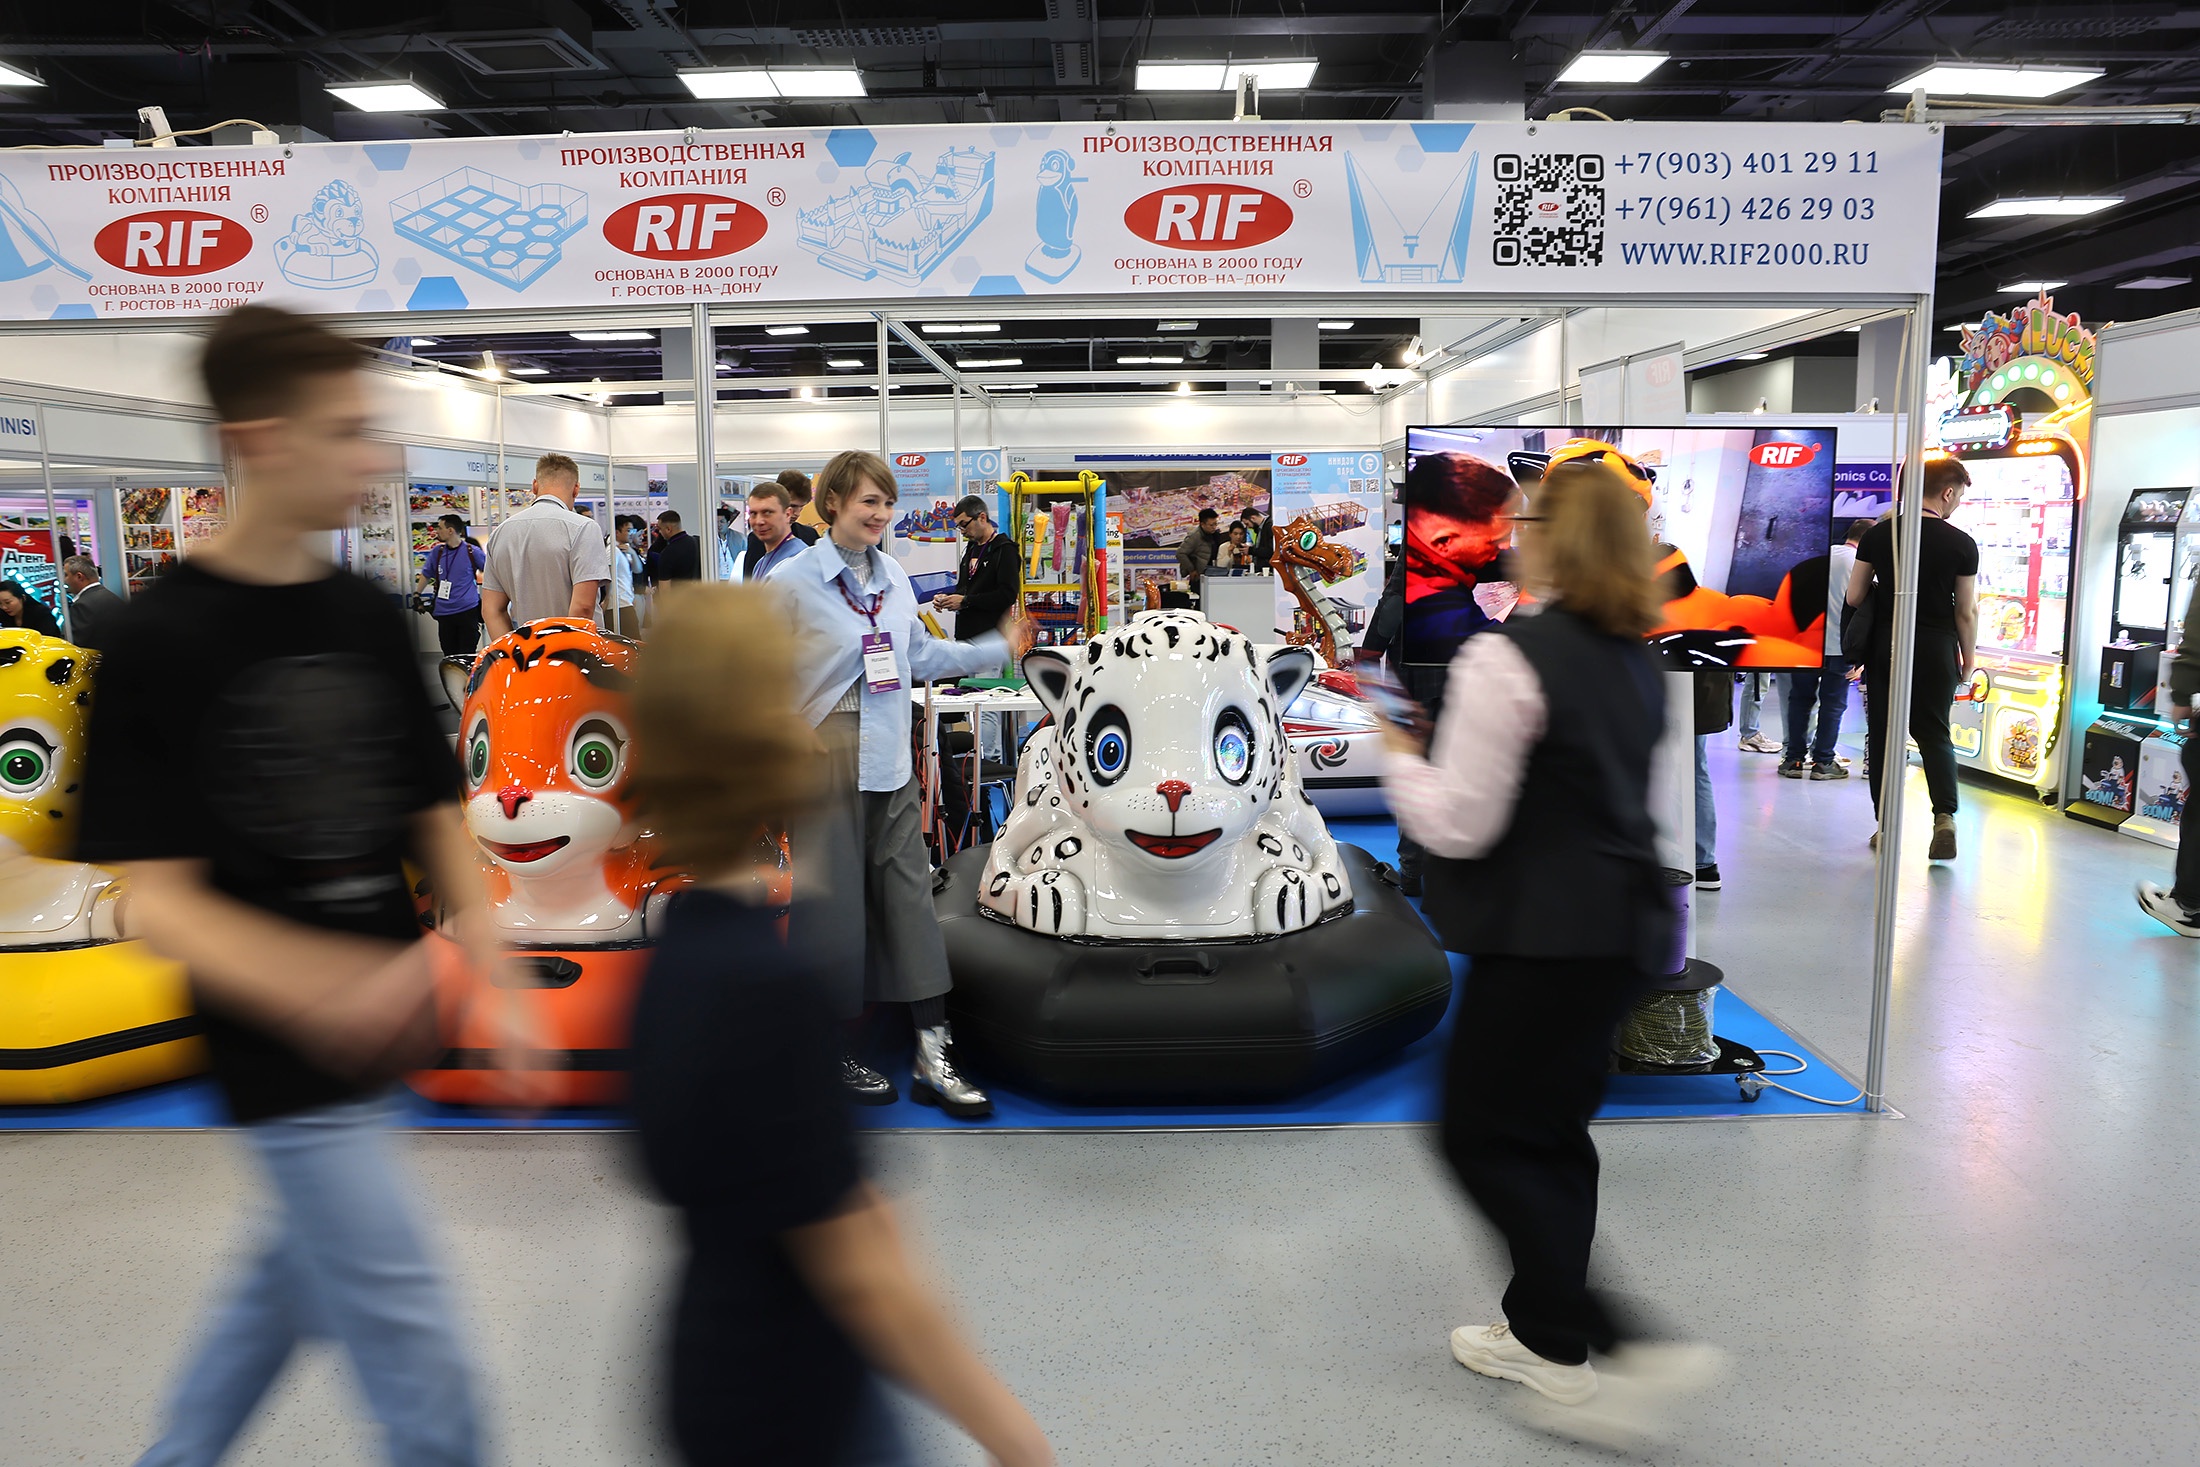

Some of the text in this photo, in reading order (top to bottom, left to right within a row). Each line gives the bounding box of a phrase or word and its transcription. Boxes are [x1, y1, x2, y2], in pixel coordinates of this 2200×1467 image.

[1083, 135, 1333, 154] ПРОИЗВОДСТВЕННАЯ
[561, 142, 805, 166] ПРОИЗВОДСТВЕННАЯ
[48, 159, 286, 183] ПРОИЗВОДСТВЕННАЯ
[1143, 159, 1274, 177] КОМПАНИЯ
[1614, 150, 1879, 180] +7(903) 401 29 11
[619, 168, 747, 188] КОМПАНИЯ
[108, 186, 231, 204] КОМПАНИЯ
[1155, 194, 1262, 241] RIF
[1614, 196, 1875, 226] +7(961) 426 29 03
[633, 203, 737, 252] RIF
[125, 220, 223, 267] RIF
[1620, 242, 1870, 266] WWW.RIF2000.RU
[1114, 257, 1303, 270] ОСНОВАНА В 2000 ГОДУ
[595, 266, 779, 282] ОСНОВАНА В 2000 ГОДУ
[1131, 273, 1286, 286] Г. РОСТОВ-НА-ДОНУ
[89, 280, 265, 296] ОСНОВАНА В 2000 ГОДУ
[611, 282, 762, 298] Г. РОСТОВ-НА-ДОНУ
[105, 300, 116, 312] Г.
[900, 456, 920, 466] RIF
[1282, 455, 1303, 465] RIF
[1760, 446, 1803, 465] RIF
[1105, 528, 1120, 538] ing
